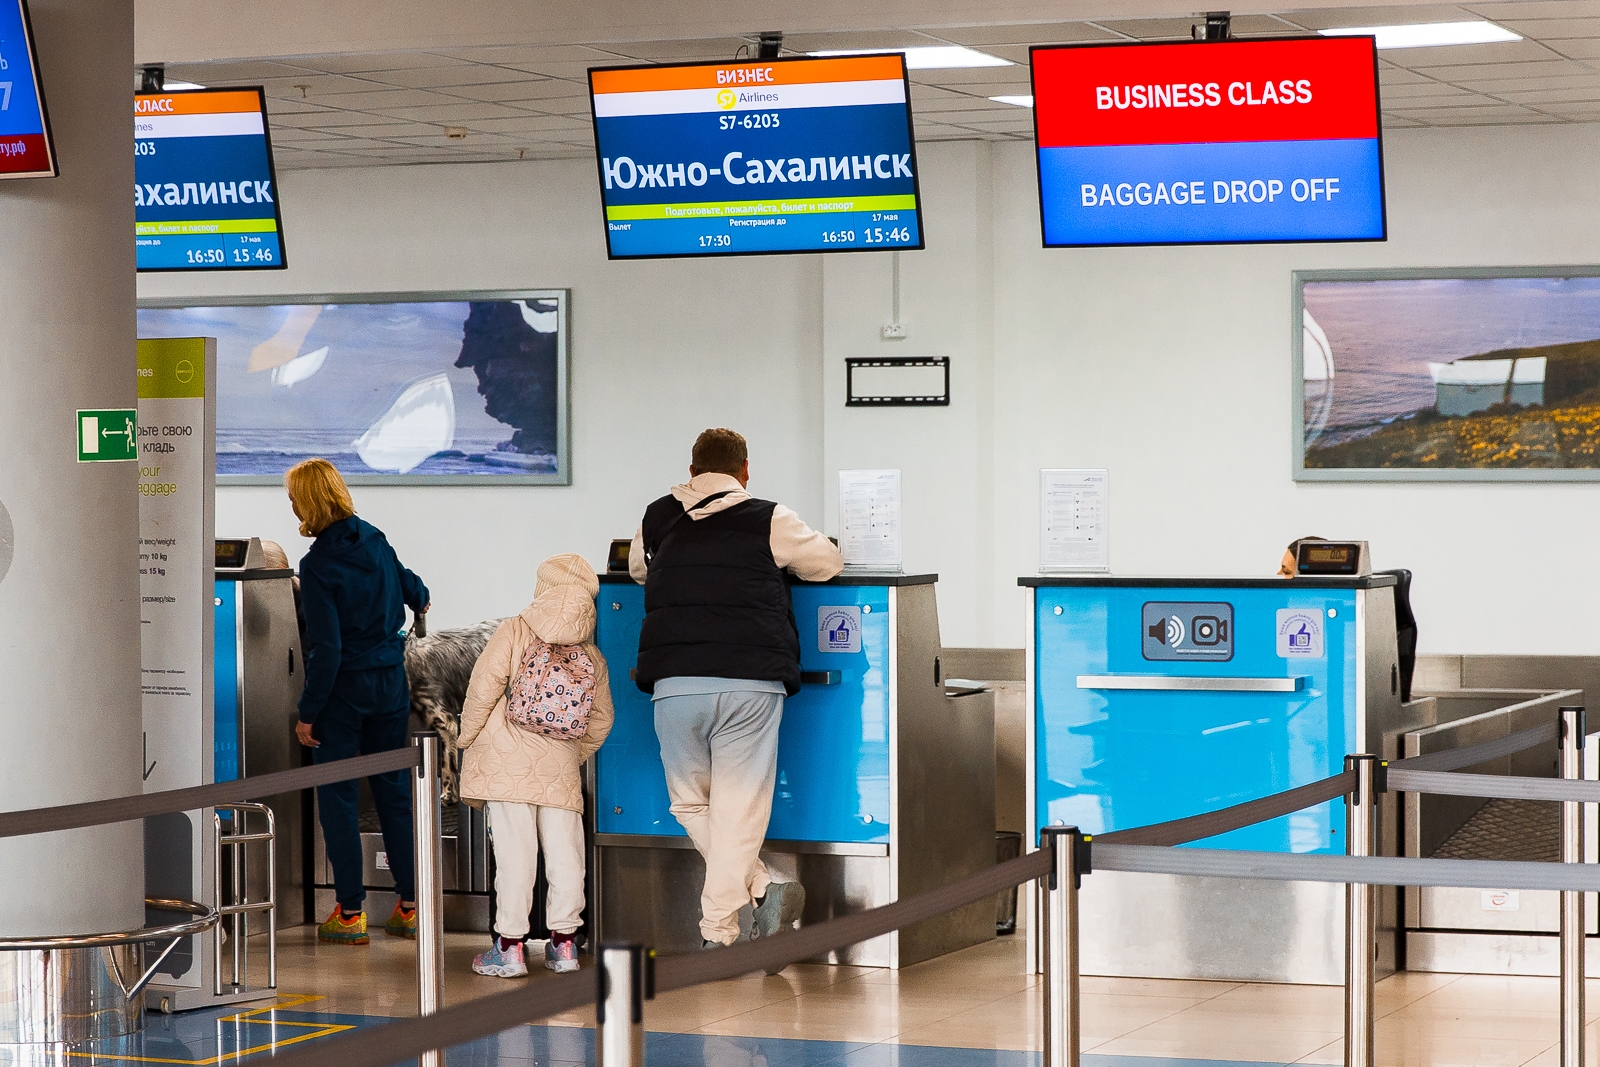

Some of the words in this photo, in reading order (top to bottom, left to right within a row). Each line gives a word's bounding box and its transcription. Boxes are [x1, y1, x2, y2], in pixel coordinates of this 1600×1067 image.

[717, 67, 774, 84] БИЗНЕС
[739, 92, 779, 103] Airlines
[1096, 82, 1221, 110] BUSINESS
[1228, 79, 1313, 106] CLASS
[134, 98, 174, 113] КЛАСС
[719, 113, 780, 130] S7-6203
[602, 151, 914, 190] Южно-Сахалинск
[1081, 181, 1206, 207] BAGGAGE
[1213, 179, 1284, 204] DROP
[1290, 178, 1340, 202] OFF
[665, 206, 723, 217] Подготовьте,
[724, 204, 780, 215] пожалуйста,
[781, 202, 807, 212] билет
[809, 203, 815, 211] и
[817, 202, 854, 212] паспорт
[729, 219, 775, 228] Регистрация
[776, 218, 787, 226] до
[872, 213, 882, 222] 17
[189, 225, 219, 234] паспорт
[608, 223, 632, 231] Вылет
[240, 235, 248, 243] 17
[698, 234, 731, 247] 17:30
[822, 230, 856, 243] 16:50
[863, 226, 911, 244] 15:46
[186, 249, 225, 264] 16:50
[233, 248, 273, 263] 15:46
[162, 426, 192, 436] свою
[143, 442, 175, 454] кладь
[160, 553, 168, 561] kg
[149, 567, 157, 575] 15
